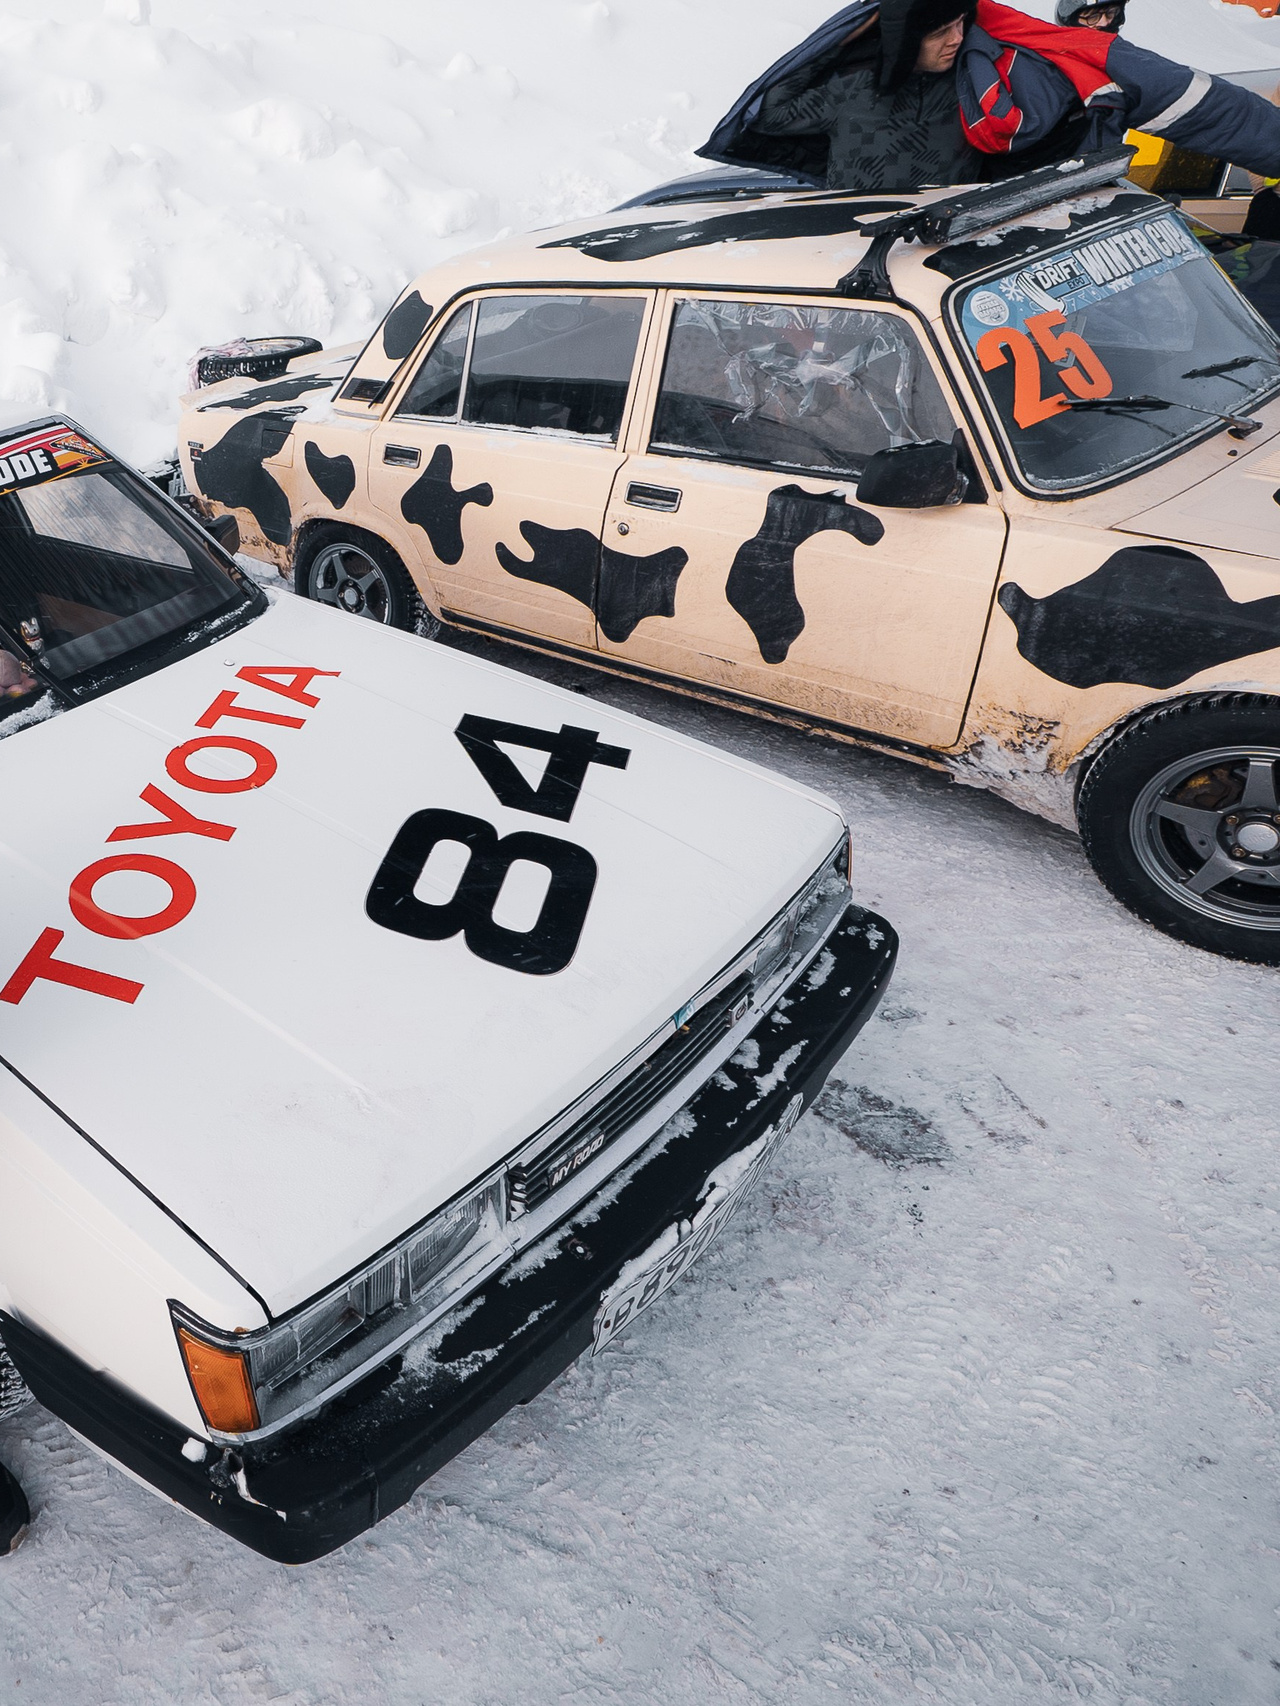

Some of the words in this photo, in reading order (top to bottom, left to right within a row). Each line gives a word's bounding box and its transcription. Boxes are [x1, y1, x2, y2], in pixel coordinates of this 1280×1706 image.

[1036, 259, 1081, 290] DRIFT
[1068, 277, 1085, 289] EXPO
[1073, 229, 1161, 286] WINTER
[976, 309, 1113, 430] 25
[363, 713, 632, 977] 84
[552, 1161, 572, 1186] MY
[573, 1134, 605, 1169] ROAD
